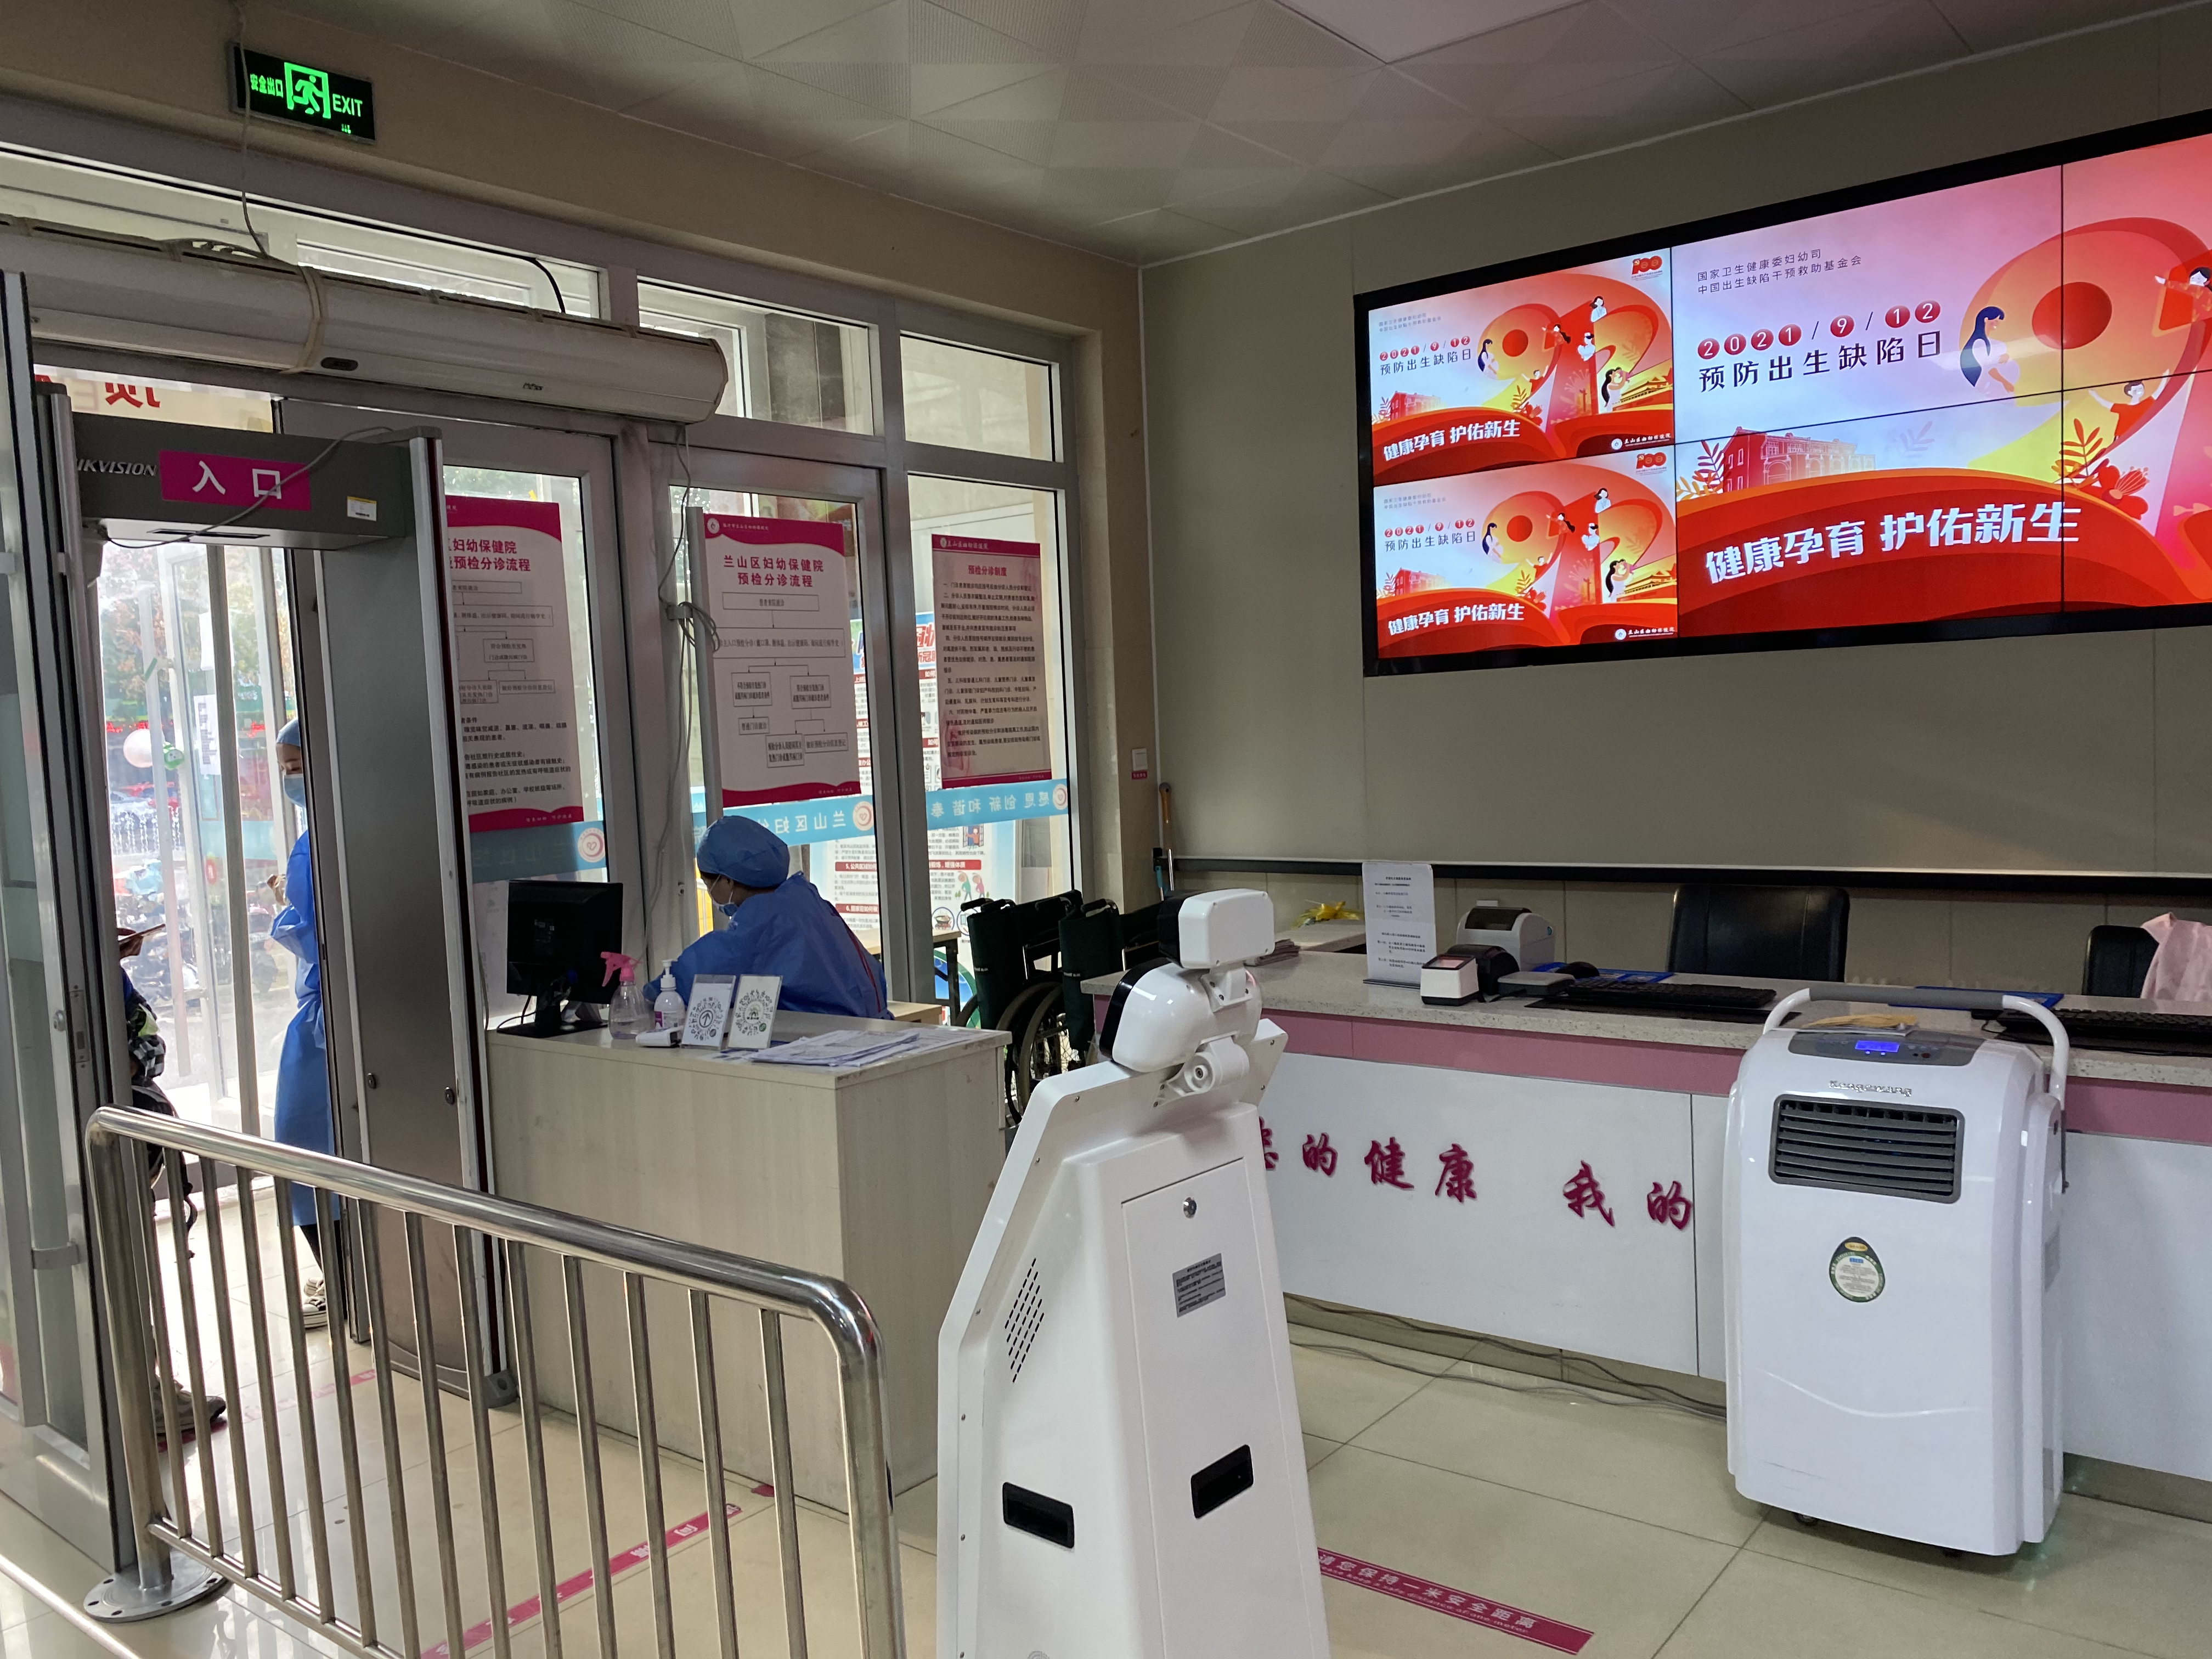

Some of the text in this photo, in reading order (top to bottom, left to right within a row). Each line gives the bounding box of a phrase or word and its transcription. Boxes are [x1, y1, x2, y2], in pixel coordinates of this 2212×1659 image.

[250, 73, 284, 98] 安全出口
[332, 93, 363, 117] EXIT
[1698, 249, 1821, 282] 国家卫生健康委妇幼司
[1698, 255, 1861, 295] 中国出生缺陷干预救助基金会
[1380, 349, 1471, 376] 预防出生缺陷日
[1699, 331, 1940, 393] 预防出生缺陷日
[1384, 419, 1521, 461] 健康孕育 护佑新生
[77, 458, 157, 477] IKVISION
[193, 460, 282, 499] 入口
[1385, 531, 1475, 552] 预防出生缺陷日
[1706, 501, 2081, 584] 健康孕育 护佑新生
[724, 555, 824, 572] 兰山区妇幼保健院
[738, 572, 813, 588] 预检分诊流程
[1388, 602, 1525, 636] 健康孕育 护佑新生
